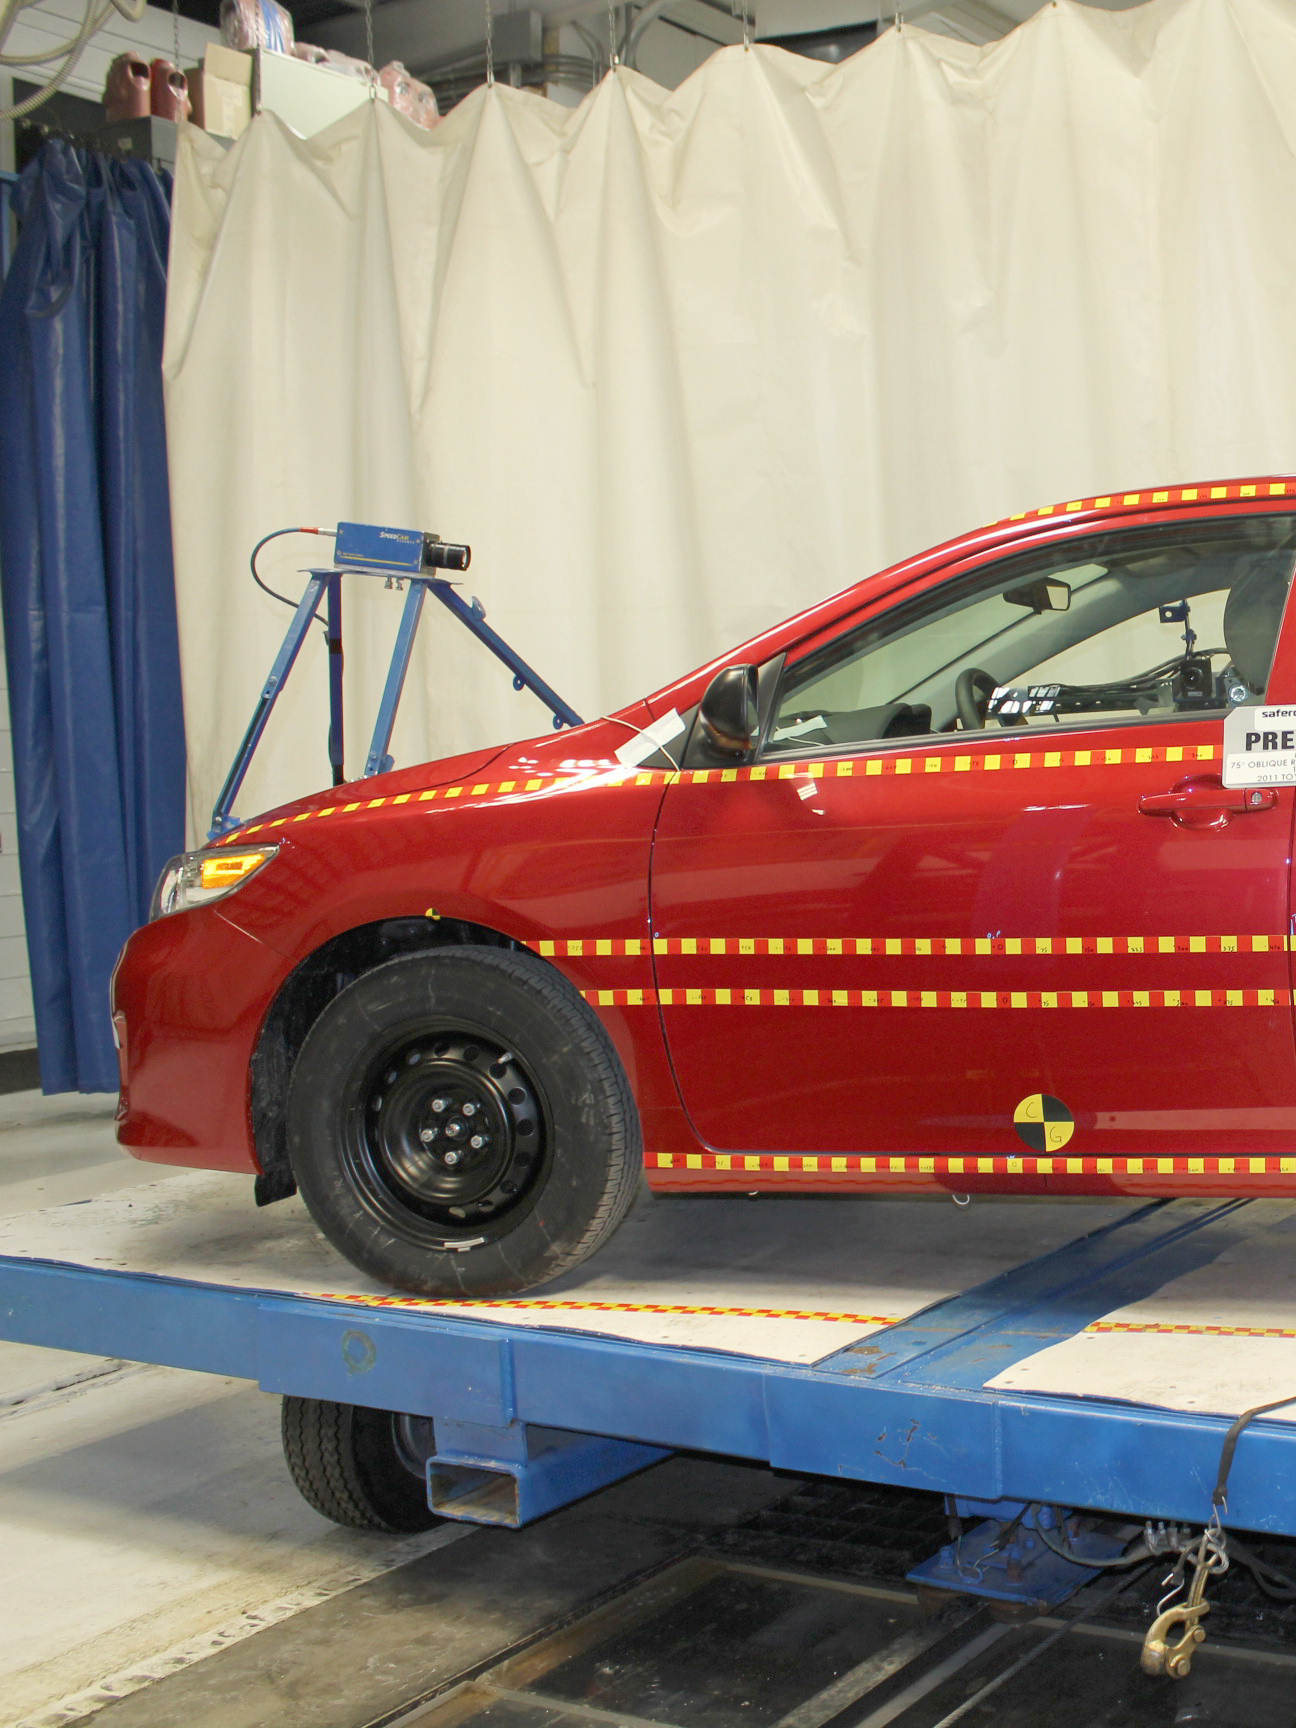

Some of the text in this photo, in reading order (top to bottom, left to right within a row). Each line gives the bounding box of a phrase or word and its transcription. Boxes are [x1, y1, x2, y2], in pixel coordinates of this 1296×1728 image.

[1248, 759, 1288, 768] OBLIQUE
[1257, 774, 1278, 782] 2011
[1026, 1102, 1037, 1119] C
[1050, 1126, 1063, 1143] G
